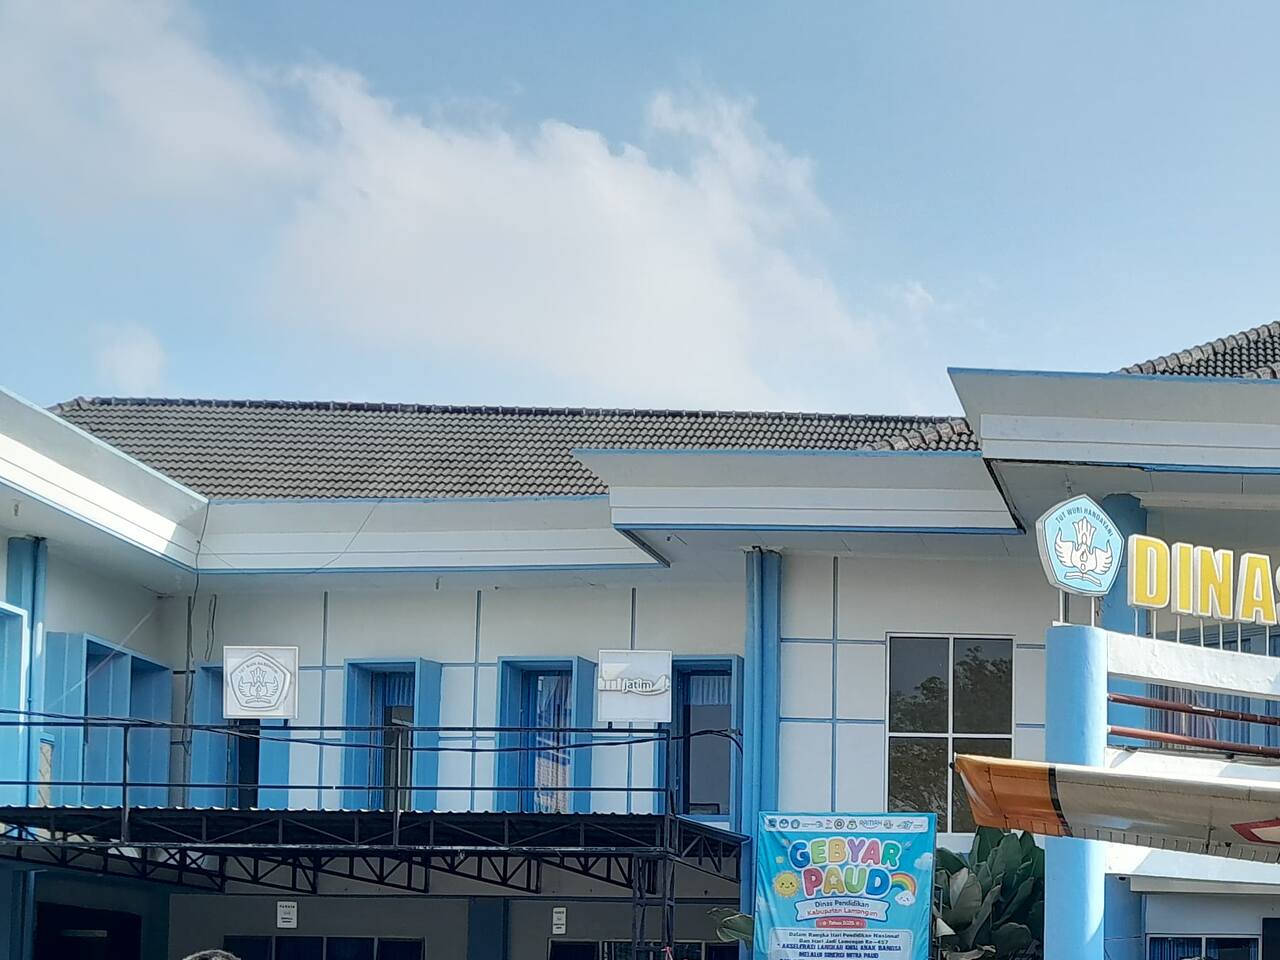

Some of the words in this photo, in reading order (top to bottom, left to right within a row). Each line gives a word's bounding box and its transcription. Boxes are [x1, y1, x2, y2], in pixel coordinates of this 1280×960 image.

[1055, 513, 1066, 524] TUT
[1067, 507, 1083, 516] WURI
[1083, 507, 1114, 537] HANDAYANI
[623, 679, 651, 691] jatim
[789, 838, 902, 868] GEBYAR
[803, 866, 892, 897] PAUD
[807, 908, 843, 916] Kabupaten
[844, 908, 878, 917] Lamongan
[815, 900, 833, 908] Dinas
[834, 899, 870, 908] Pendidikan
